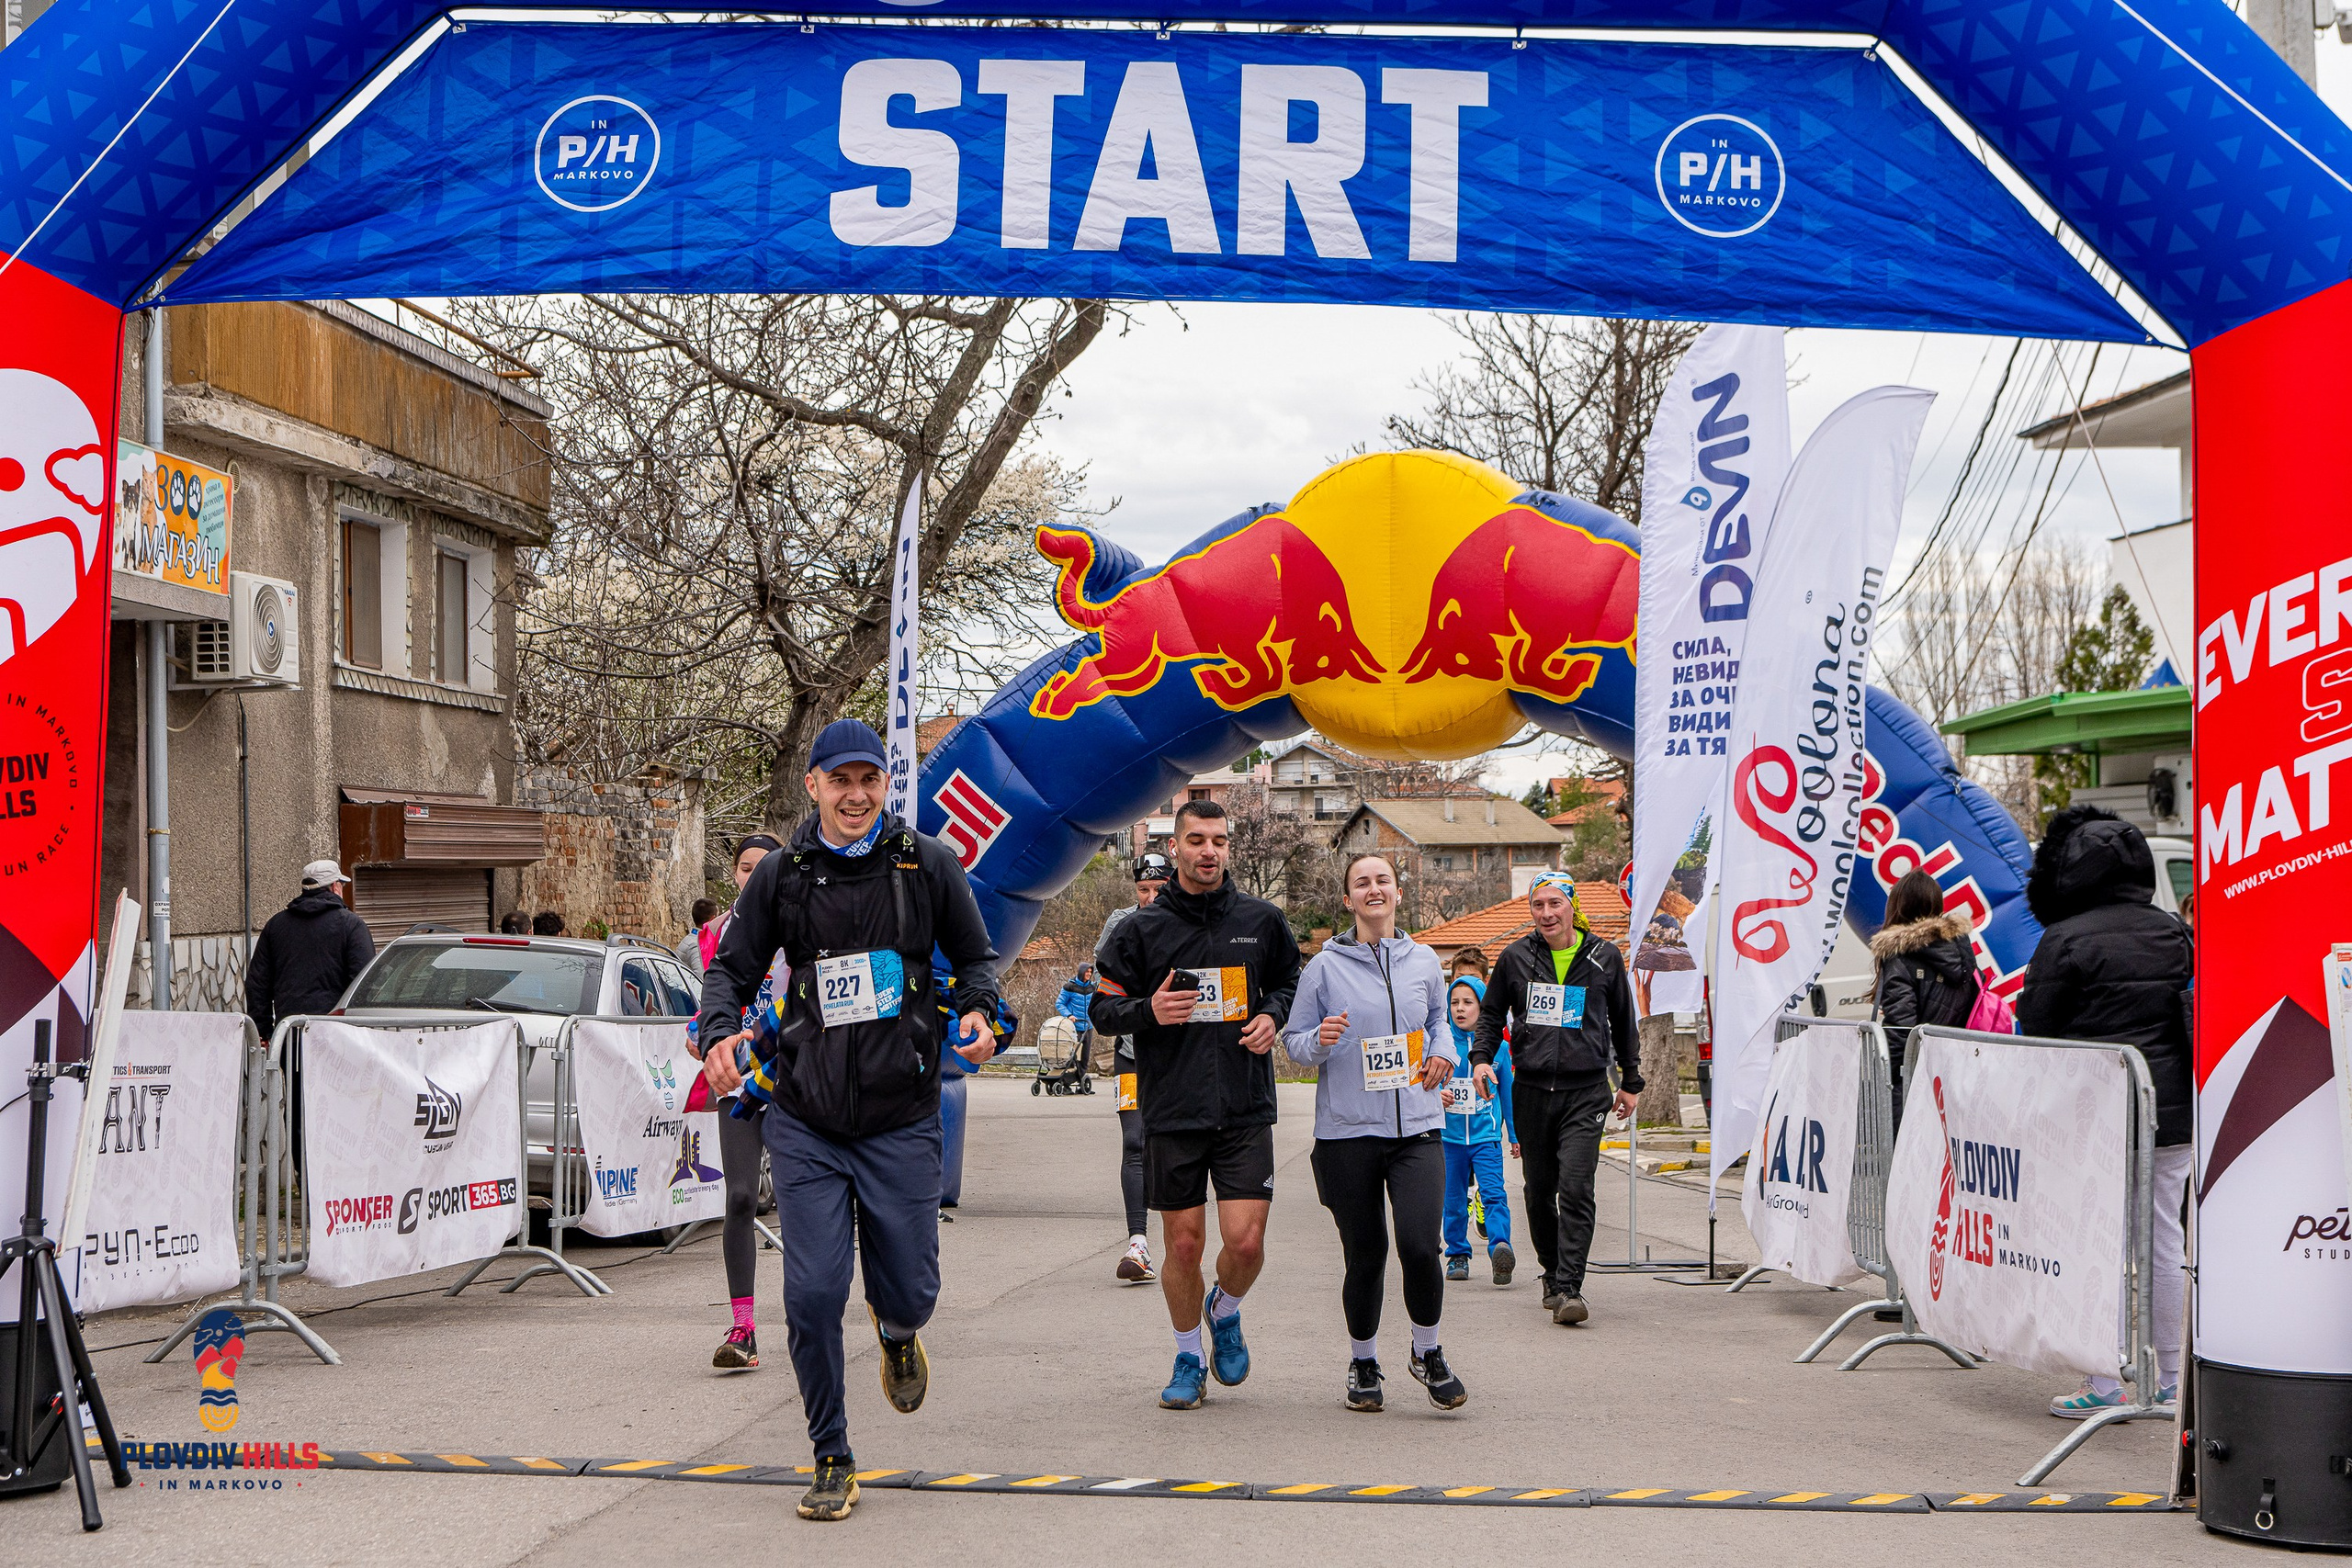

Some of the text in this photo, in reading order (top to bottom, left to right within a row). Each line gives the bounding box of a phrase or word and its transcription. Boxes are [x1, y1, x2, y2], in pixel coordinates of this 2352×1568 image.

[591, 119, 607, 130] IN
[557, 134, 639, 169] P/H
[1712, 139, 1728, 149] IN
[829, 58, 1489, 263] START
[553, 170, 634, 180] MARKOVO
[1679, 152, 1761, 192] P/H
[1679, 194, 1761, 208] MARKOVO
[141, 523, 220, 585] МАГАЗИН
[1672, 636, 1731, 660] СИЛА,
[1669, 689, 1695, 708] ЗА
[1668, 711, 1731, 733] ВИДИ
[7, 693, 78, 788] IN MARKOVO
[1665, 737, 1726, 756] ЗА ТЯ
[37, 823, 69, 863] RACE
[840, 959, 849, 968] 8K
[825, 975, 861, 1001] 227
[1196, 984, 1216, 1002] 53
[1532, 995, 1556, 1010] 269
[1365, 1050, 1405, 1071] 1254
[672, 1188, 684, 1204] ECO
[325, 1194, 394, 1238] SPONSER
[1951, 1204, 1994, 1268] HLLS
[1998, 1223, 2009, 1240] IN
[1998, 1248, 2061, 1277] MARKOVO
